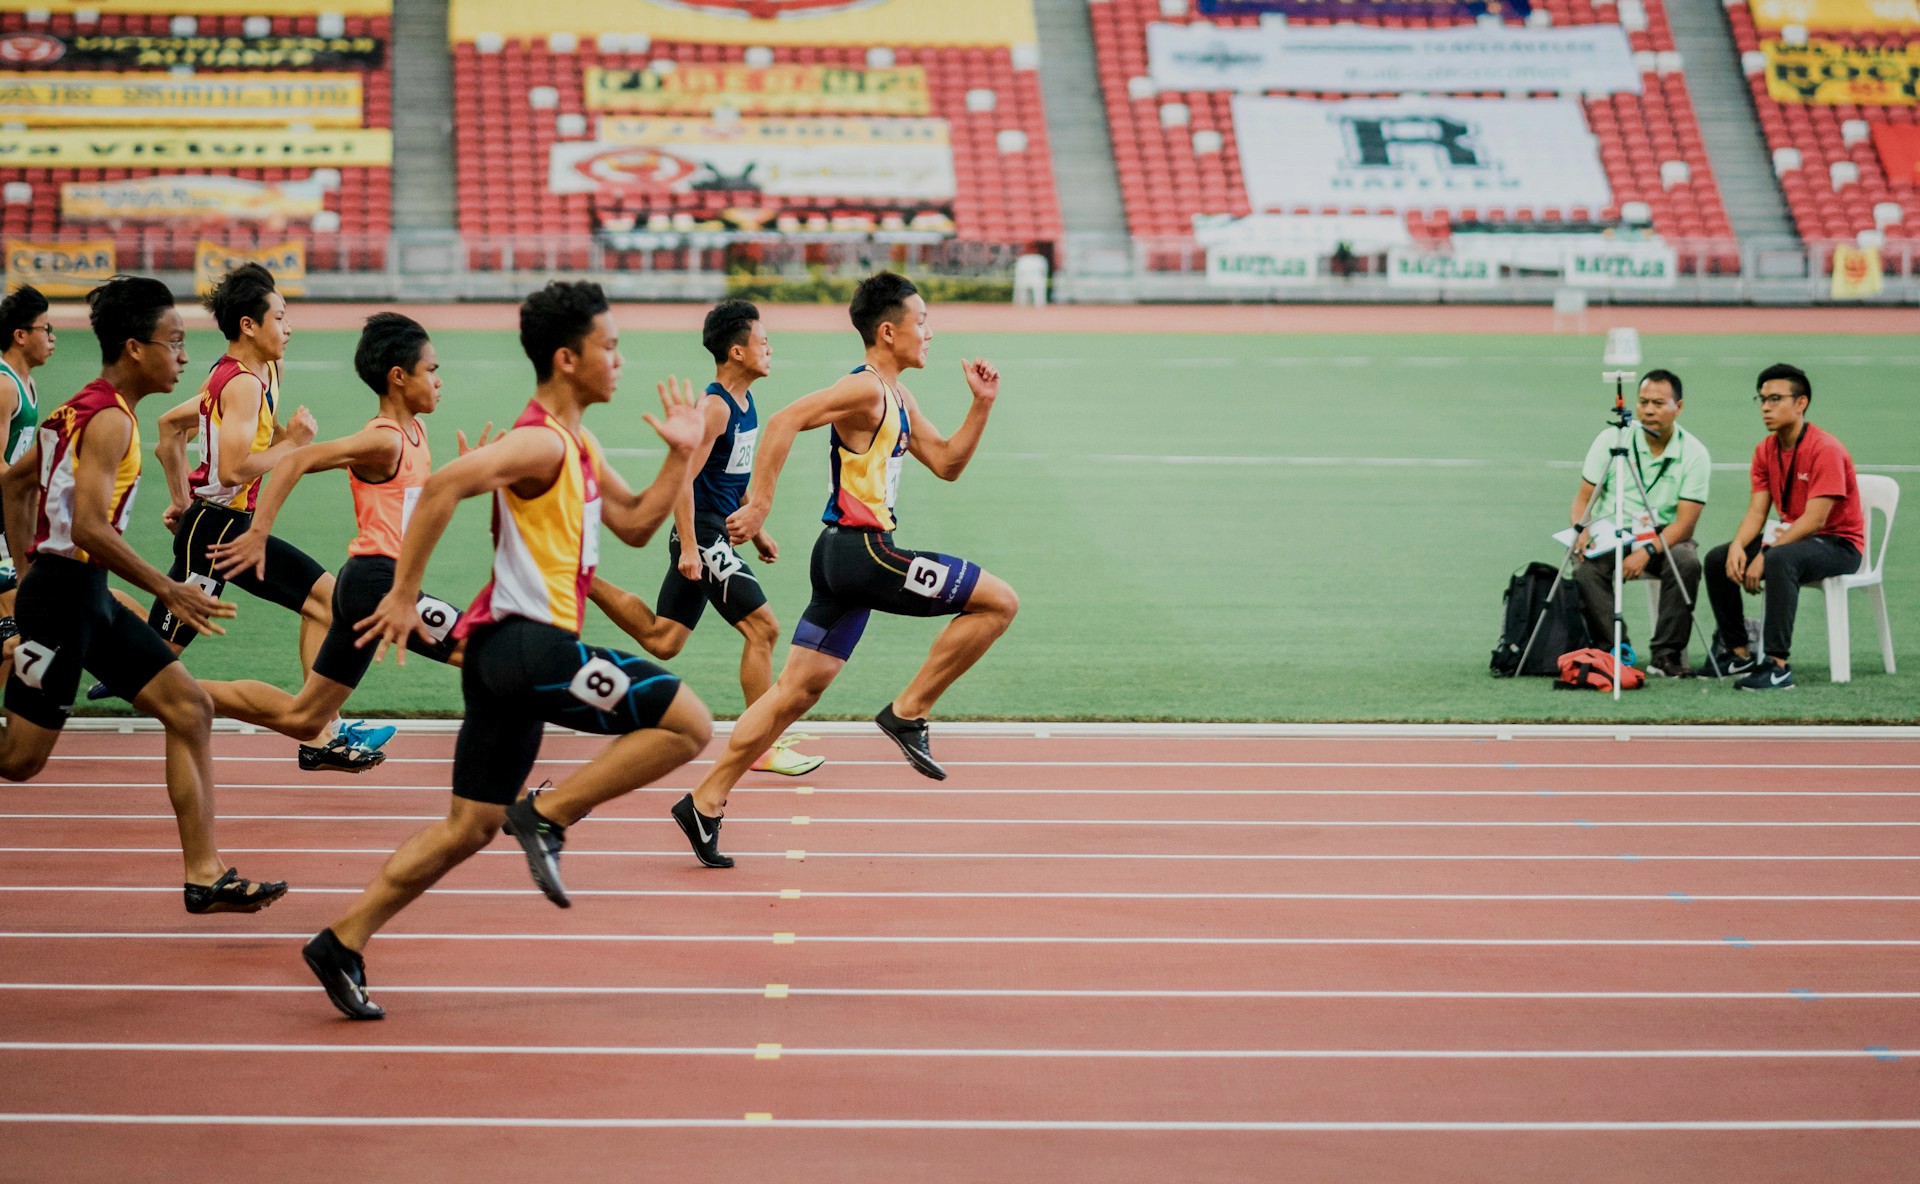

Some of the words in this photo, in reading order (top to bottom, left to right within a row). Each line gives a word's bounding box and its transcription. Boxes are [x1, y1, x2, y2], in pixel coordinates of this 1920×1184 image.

[11, 250, 111, 273] CEDAR
[203, 249, 300, 271] CEAR
[735, 445, 752, 468] 28
[711, 550, 732, 573] 2
[913, 565, 938, 589] 5
[420, 605, 447, 628] 6
[22, 647, 43, 676] 7
[586, 671, 615, 698] 8
